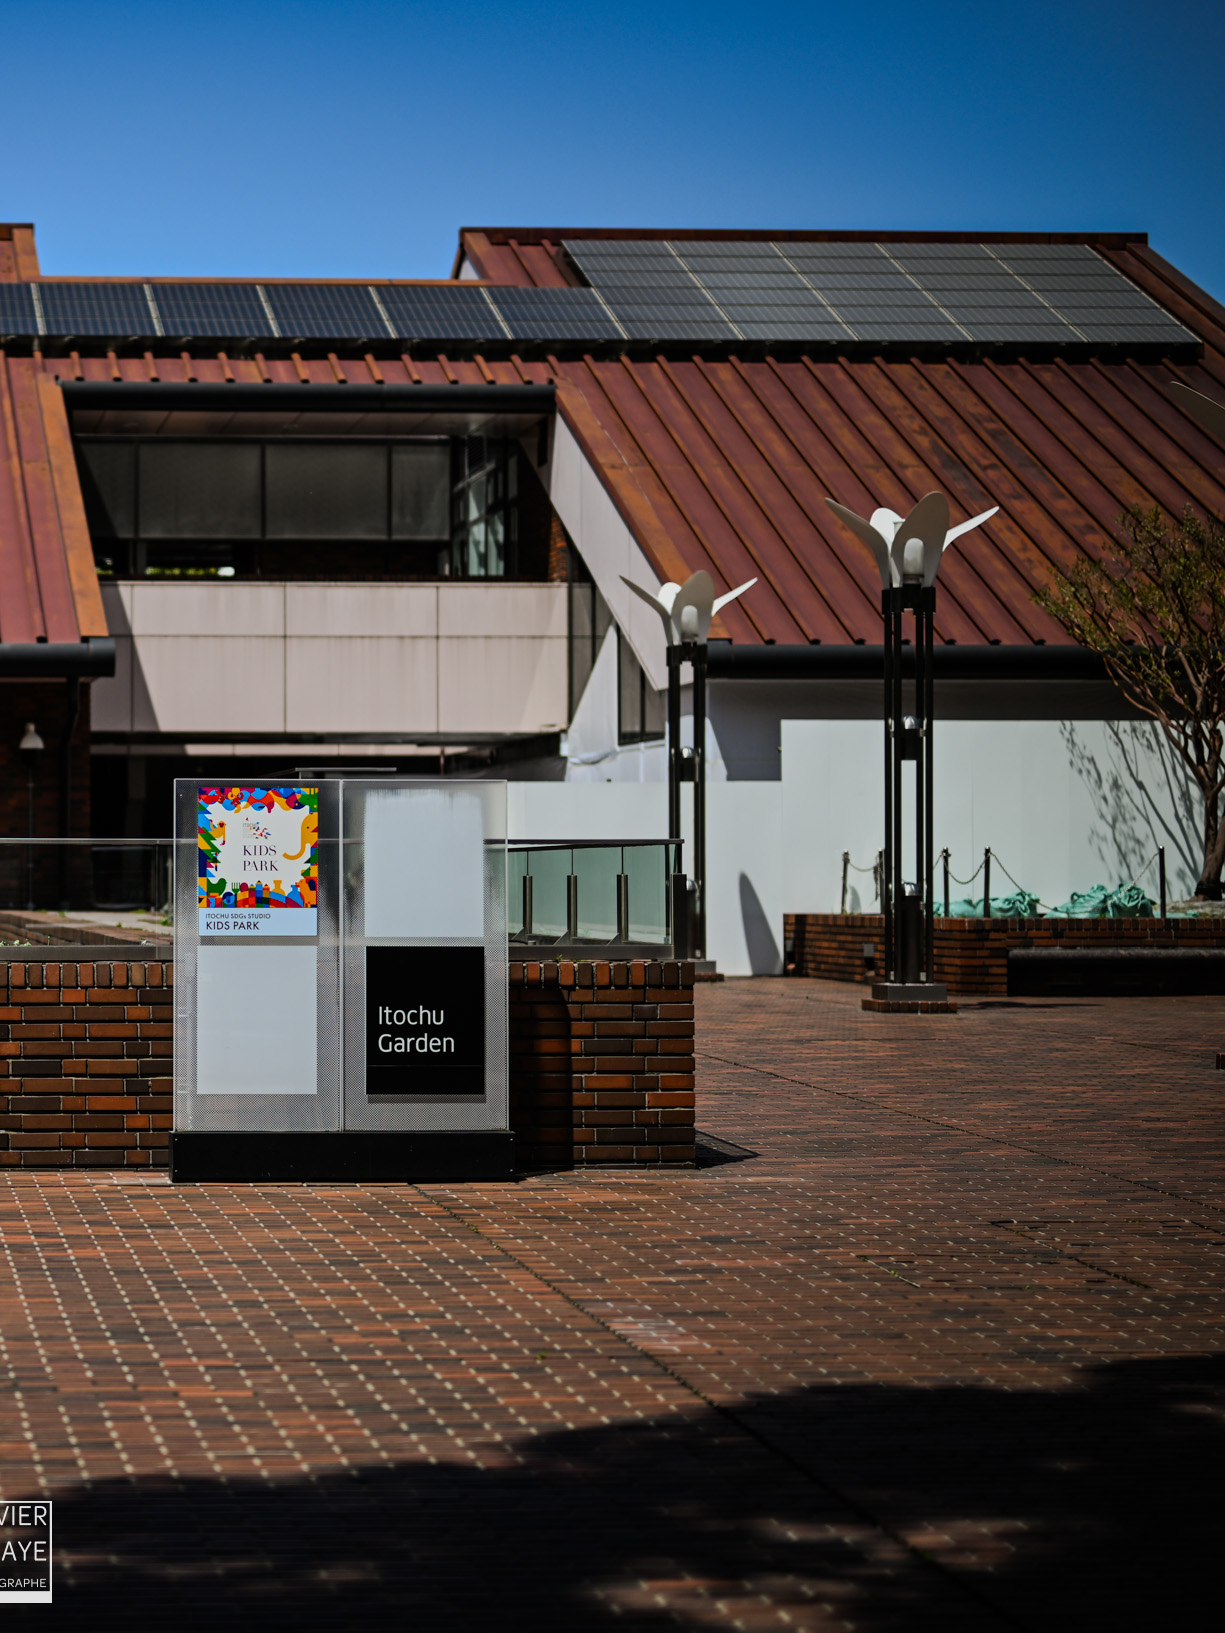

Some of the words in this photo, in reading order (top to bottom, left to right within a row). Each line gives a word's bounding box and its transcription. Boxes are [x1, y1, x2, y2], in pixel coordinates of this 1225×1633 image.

[243, 845, 277, 856] KIDS
[243, 860, 279, 871] PARK
[206, 921, 230, 930] KIDS
[233, 921, 260, 930] PARK
[378, 1005, 444, 1025] Itochu
[378, 1032, 454, 1052] Garden
